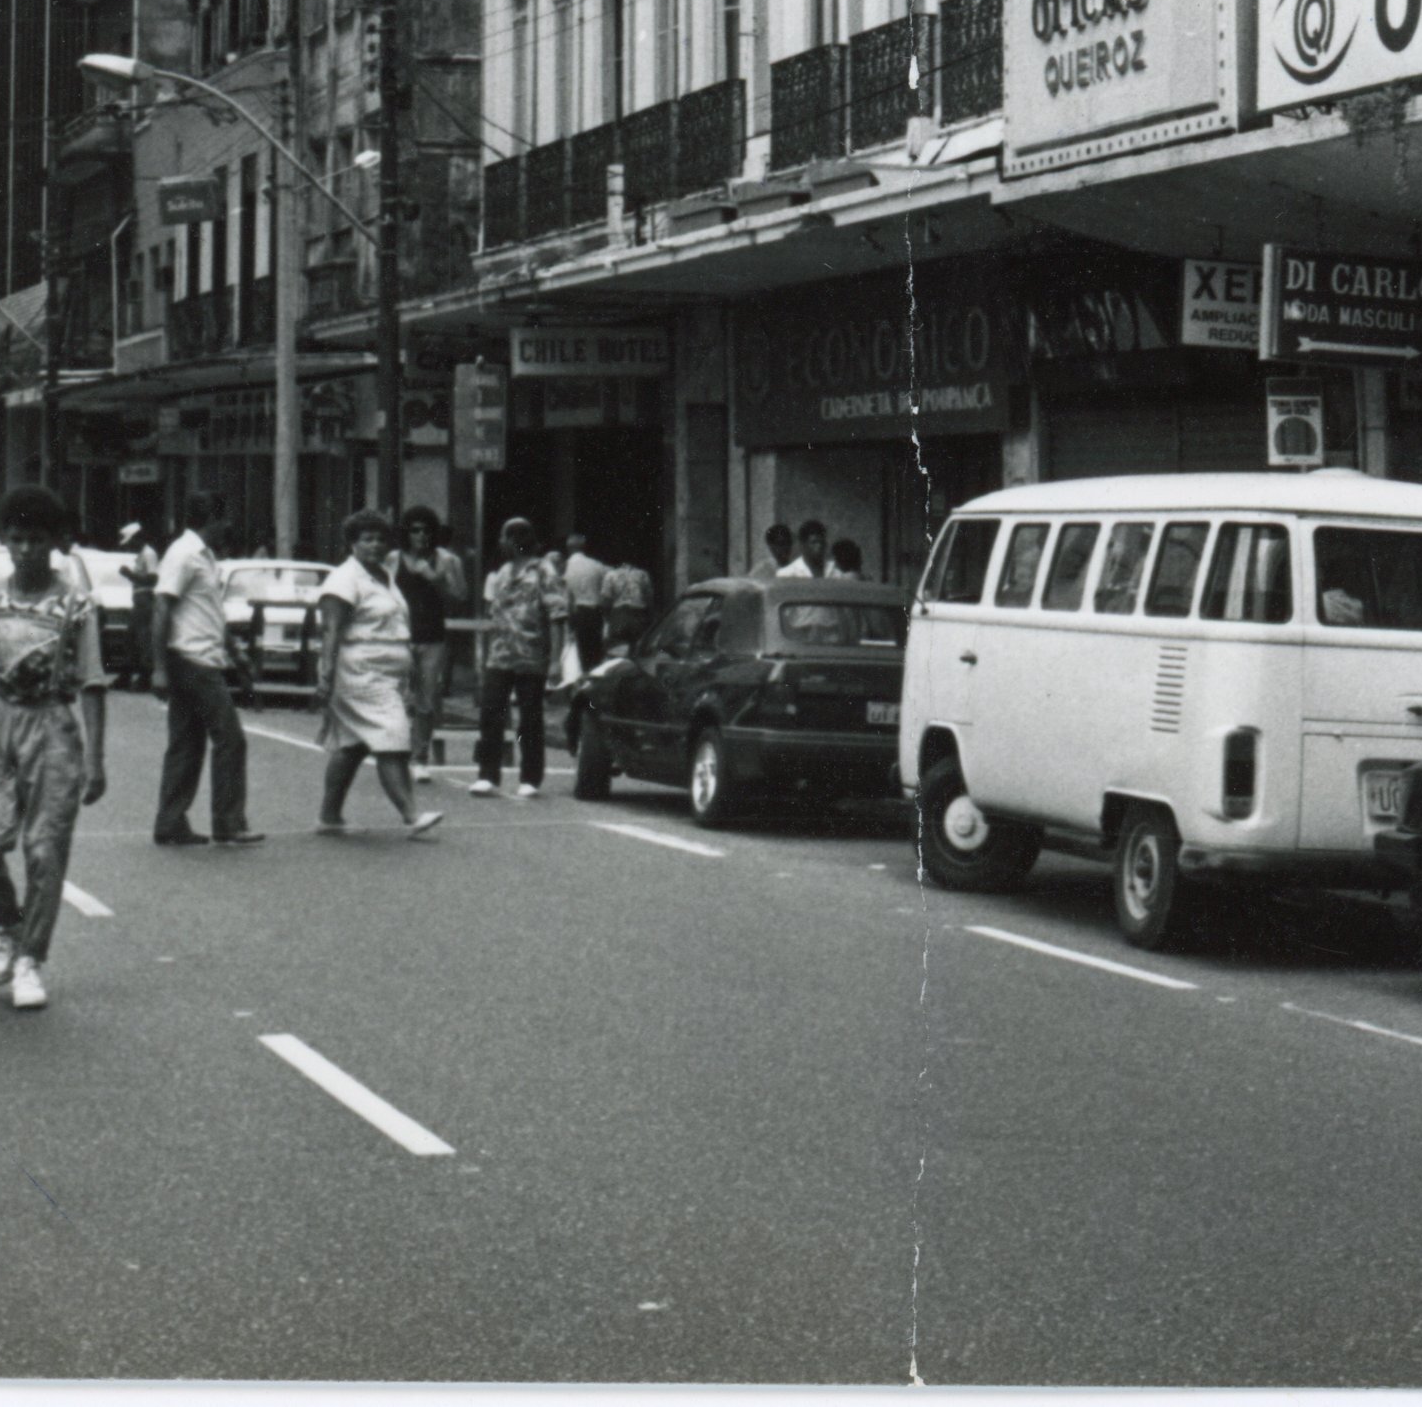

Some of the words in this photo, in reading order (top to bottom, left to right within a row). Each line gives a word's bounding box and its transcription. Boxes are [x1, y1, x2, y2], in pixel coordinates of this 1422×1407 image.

[1044, 29, 1147, 98] QUEIROZ
[1285, 258, 1316, 292] DI
[518, 339, 587, 363] CHILE
[596, 339, 668, 363] HOTEL
